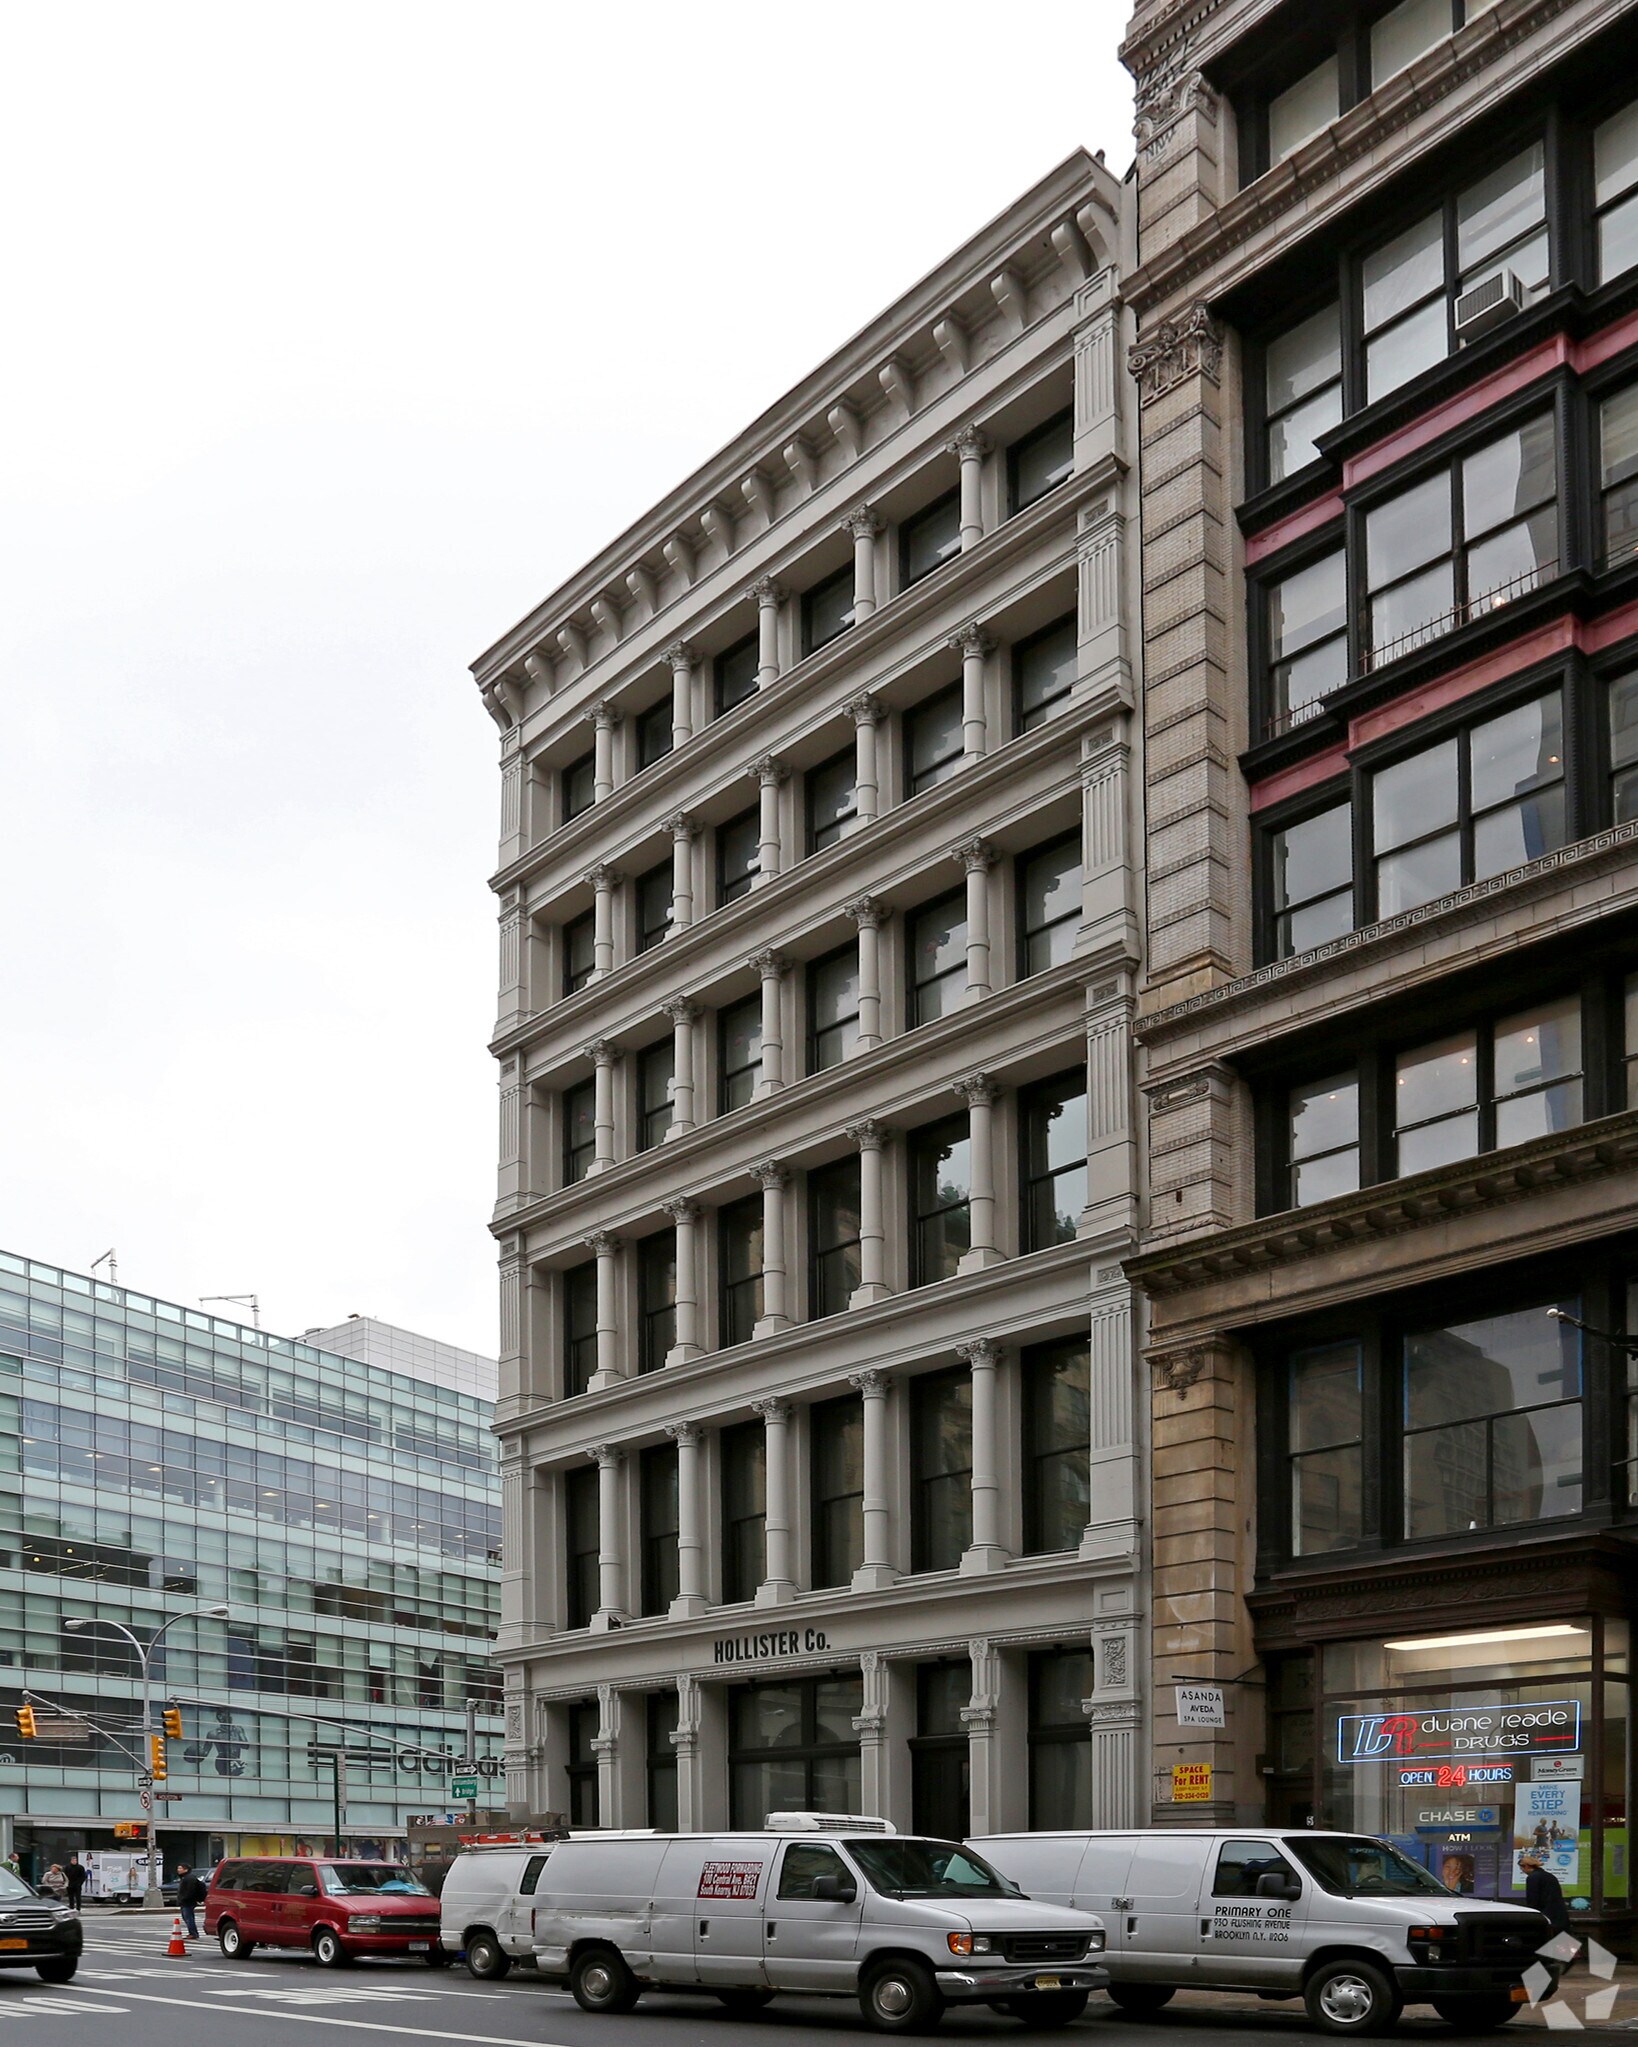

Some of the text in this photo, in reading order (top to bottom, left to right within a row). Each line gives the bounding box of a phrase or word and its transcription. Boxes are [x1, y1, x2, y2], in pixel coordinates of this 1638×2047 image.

[714, 1628, 831, 1663] HOLLISTER Co.
[1181, 1690, 1221, 1702] ASANDA
[1190, 1705, 1214, 1713] AVEDA
[1198, 1716, 1222, 1724] LOUNGE
[1421, 1716, 1492, 1733] duane
[1500, 1709, 1568, 1729] reade
[1454, 1733, 1529, 1750] DRUGS
[1179, 1766, 1204, 1774] SPACE
[1174, 1774, 1209, 1785] For RENT
[1400, 1765, 1512, 1787] OPEN 24 HOURS
[1530, 1790, 1566, 1799] EVERY
[1532, 1800, 1564, 1810] STEP
[1419, 1811, 1476, 1823] CHASE
[1447, 1833, 1471, 1842] ATM
[713, 1873, 732, 1884] Central
[700, 1884, 713, 1895] South
[732, 1885, 740, 1896] NJ
[1215, 1906, 1292, 1918] PRIMARY ONE
[1231, 1918, 1262, 1928] FLUSHING
[1265, 1920, 1291, 1929] AVENUE
[1215, 1930, 1250, 1940] BROOKLYN
